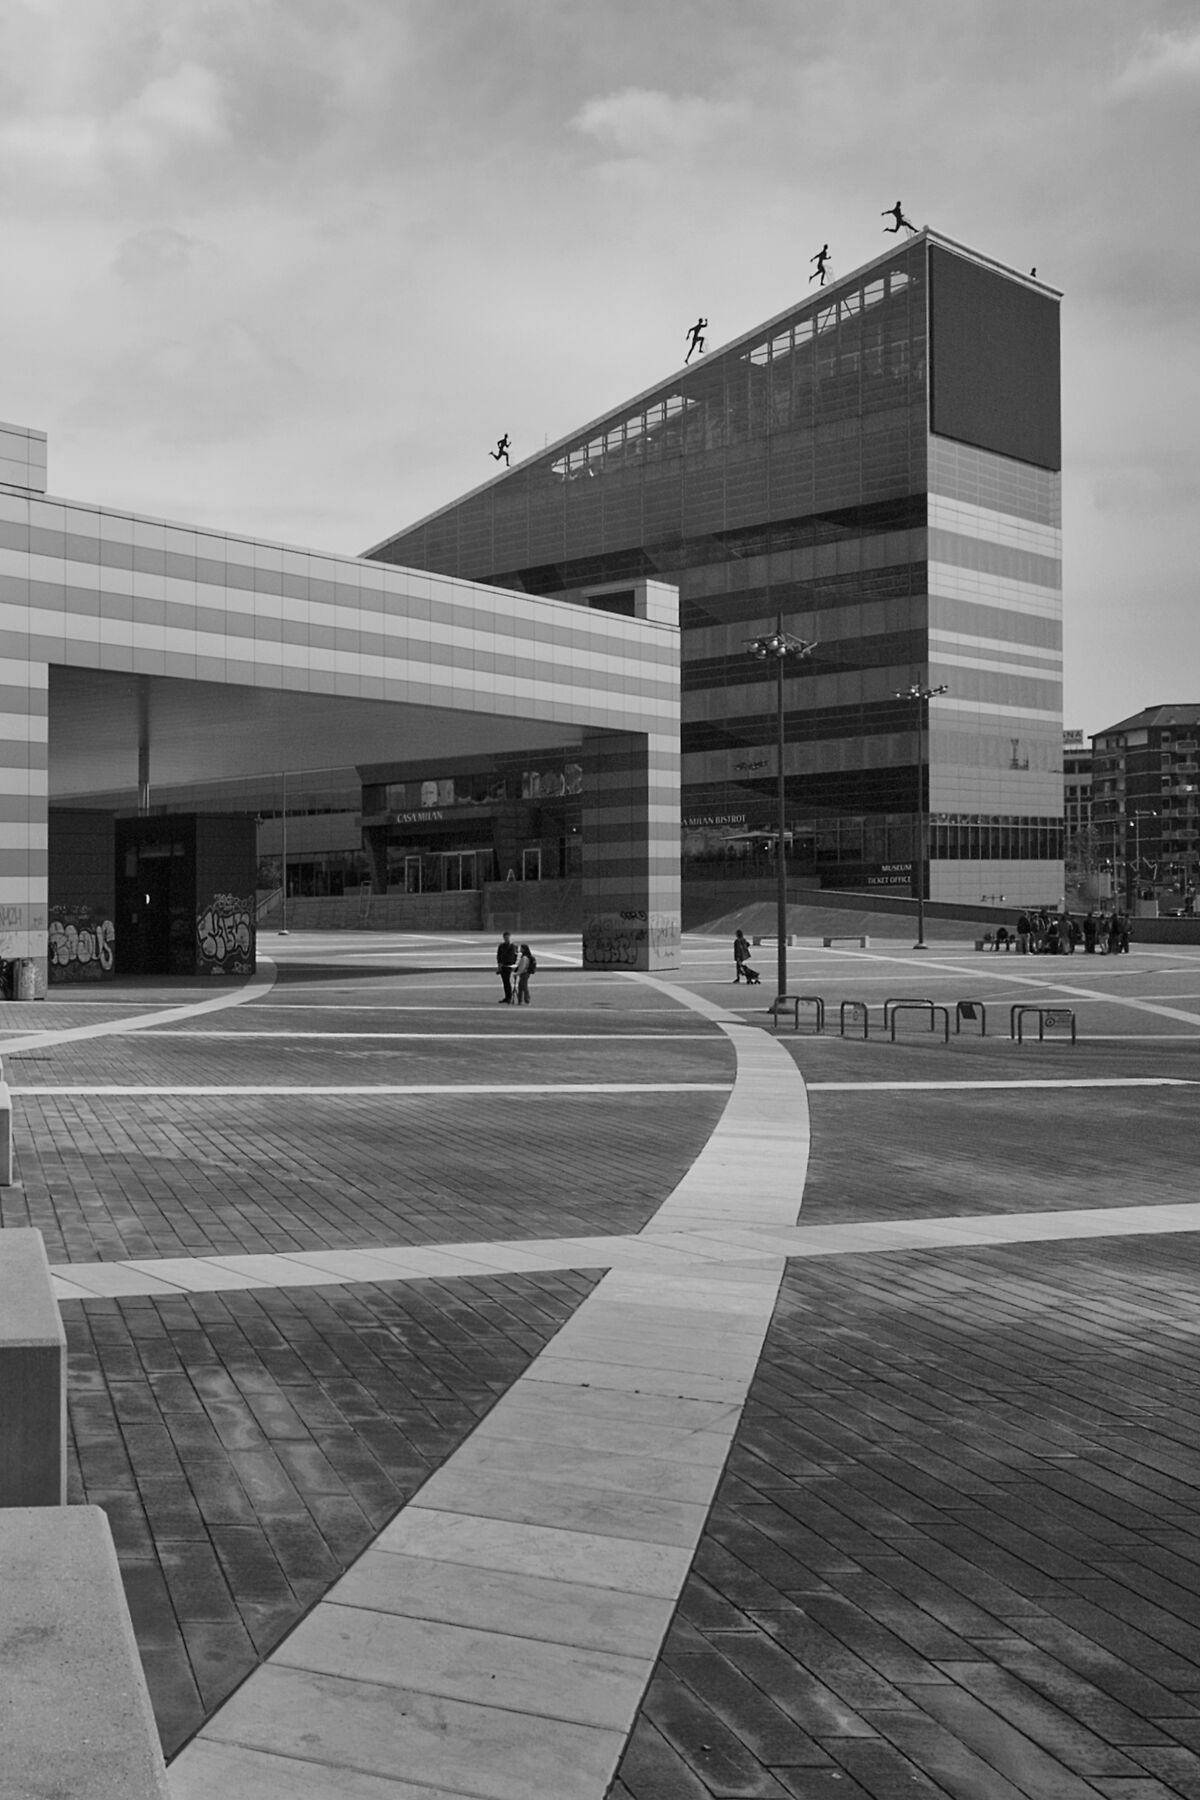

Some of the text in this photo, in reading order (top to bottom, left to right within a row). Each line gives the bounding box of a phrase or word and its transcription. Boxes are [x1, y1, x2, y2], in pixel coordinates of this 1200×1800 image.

[396, 811, 444, 823] CASA MILAN
[688, 816, 714, 825] MILAN
[714, 814, 746, 824] BISTROT
[881, 864, 912, 872] MUSEUM
[867, 875, 912, 885] TICKET OFFICE
